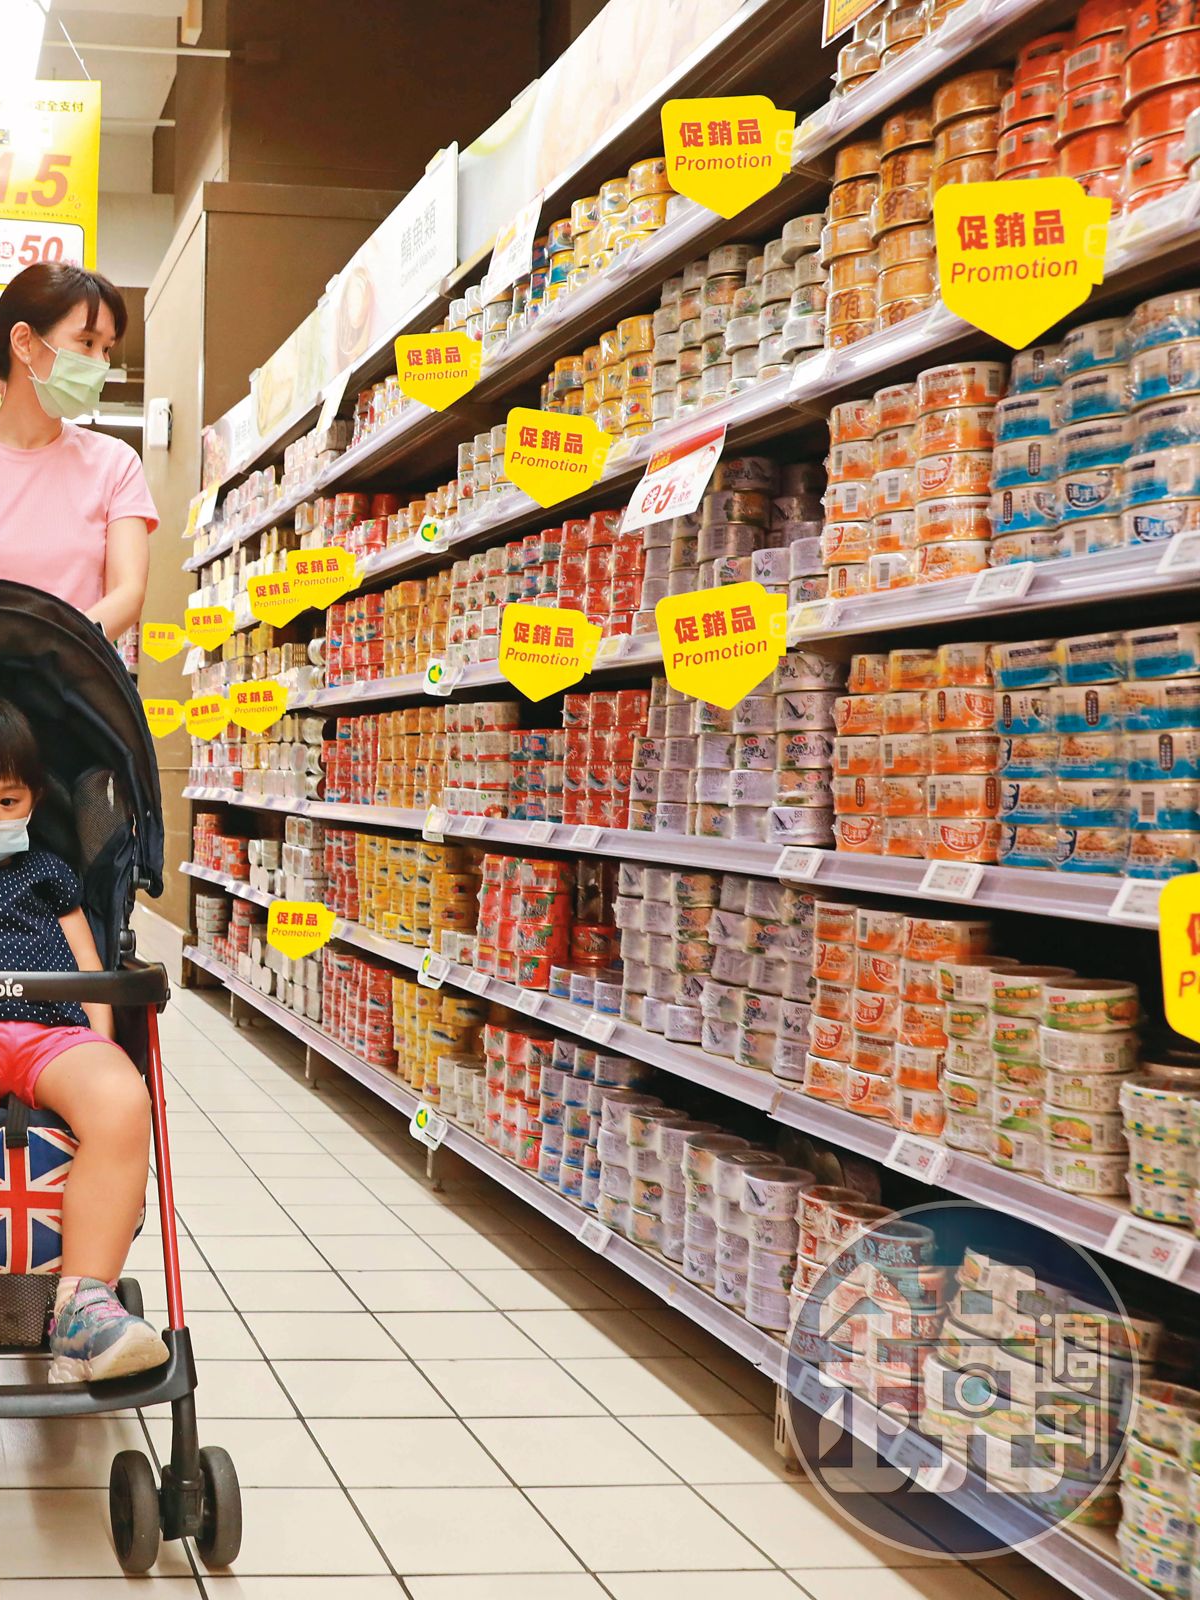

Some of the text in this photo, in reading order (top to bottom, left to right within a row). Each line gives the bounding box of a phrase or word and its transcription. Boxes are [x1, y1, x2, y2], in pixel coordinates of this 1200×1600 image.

[679, 119, 762, 148] 促銷品
[675, 153, 772, 171] Promotion
[956, 209, 1065, 251] 促銷品
[951, 257, 1078, 284] Promotion
[407, 346, 461, 367] 促銷品
[404, 369, 469, 382] Promotion
[518, 426, 584, 455] 促銷品
[510, 451, 588, 475] Promotion
[296, 558, 339, 575] 促銷品
[294, 576, 345, 588] Promotion
[191, 613, 223, 626] 促銷品
[674, 605, 756, 645] 促銷品
[513, 622, 575, 648] 促銷品
[505, 648, 580, 667] Promotion
[672, 638, 768, 669] Promotion
[237, 690, 273, 704] 促銷品
[191, 703, 220, 717] 促銷品
[234, 705, 278, 715] Promotion
[277, 912, 318, 926] 促銷品
[271, 928, 321, 938] Promotion
